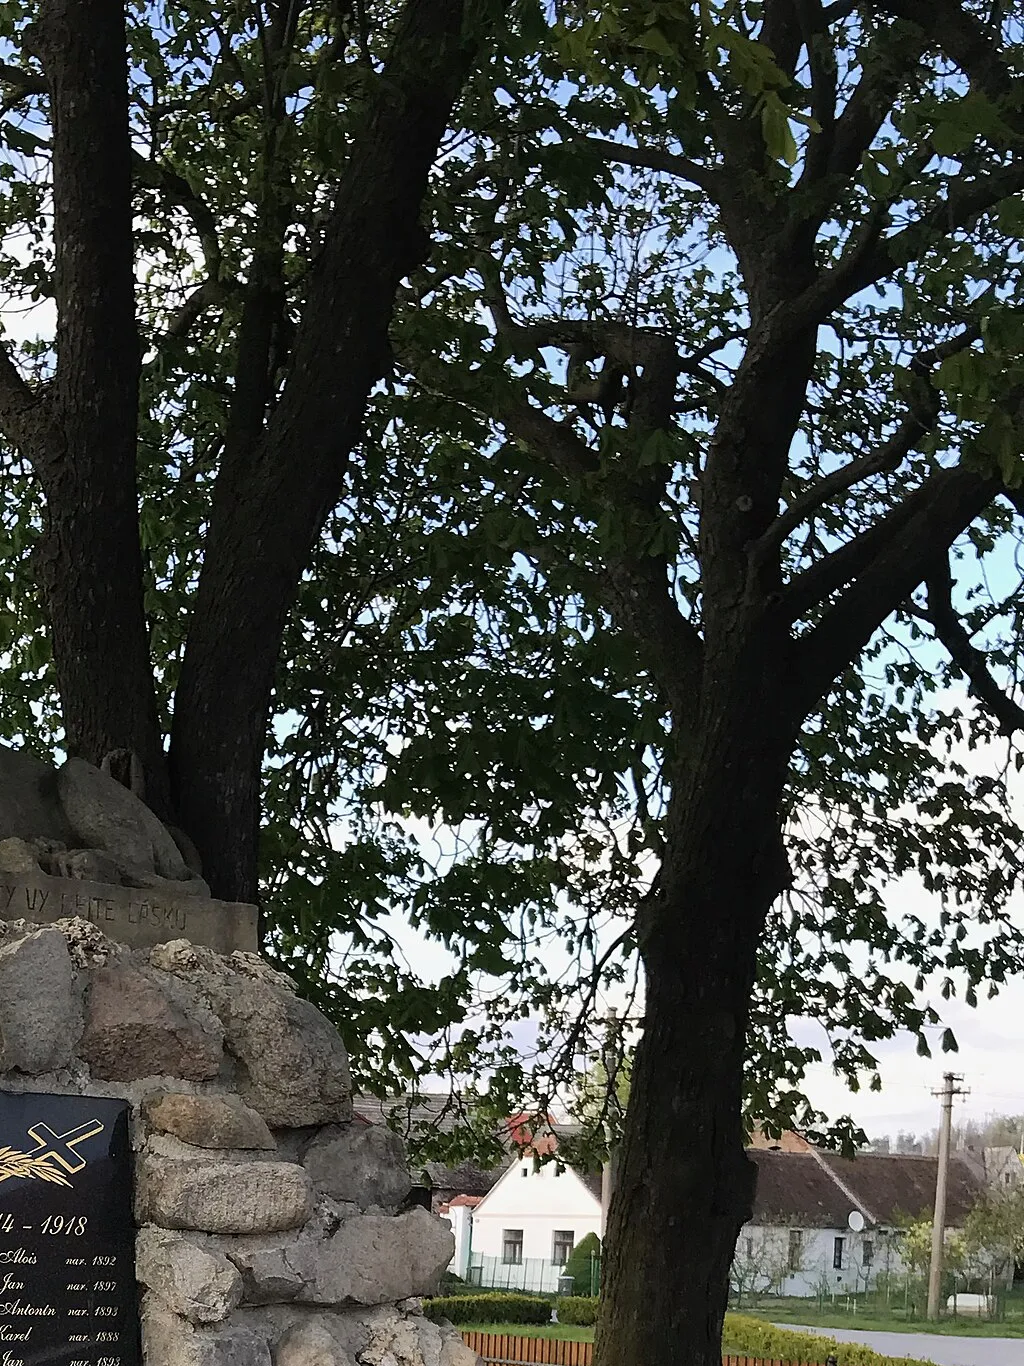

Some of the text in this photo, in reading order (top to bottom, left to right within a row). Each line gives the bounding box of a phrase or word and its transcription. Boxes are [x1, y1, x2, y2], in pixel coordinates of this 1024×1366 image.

[40, 1215, 88, 1236] 1918
[65, 1257, 87, 1266] nar.
[92, 1255, 117, 1266] 1892
[66, 1282, 88, 1291] nar.
[93, 1280, 117, 1291] 1897
[68, 1308, 89, 1316] nar.
[94, 1306, 118, 1317] 1893
[68, 1333, 91, 1342] nar.
[95, 1331, 120, 1342] 1888
